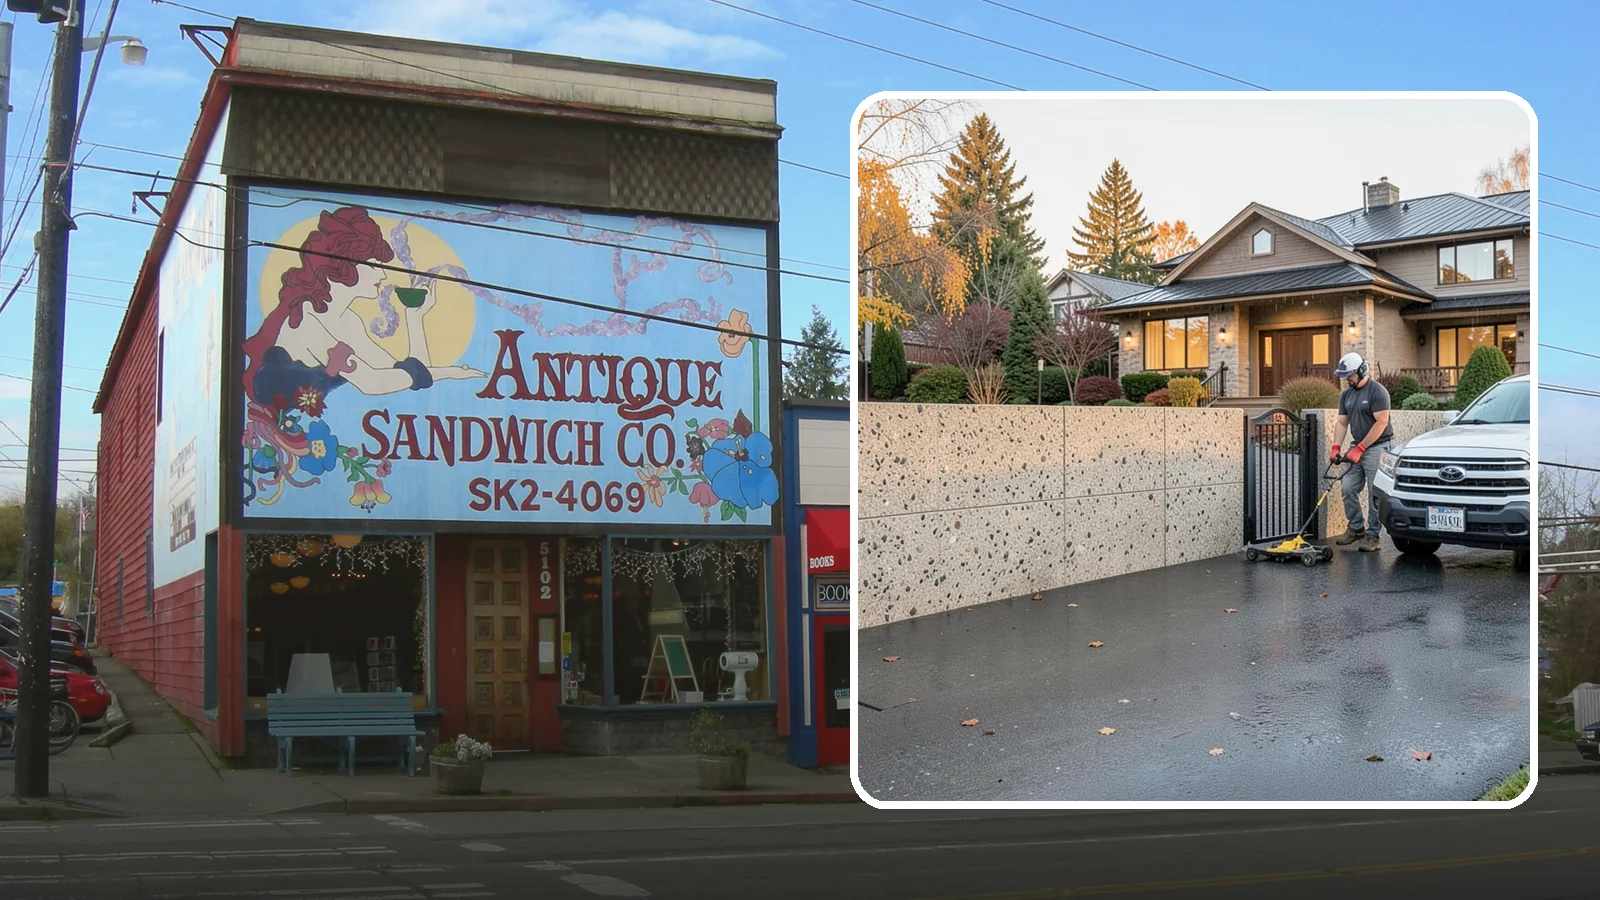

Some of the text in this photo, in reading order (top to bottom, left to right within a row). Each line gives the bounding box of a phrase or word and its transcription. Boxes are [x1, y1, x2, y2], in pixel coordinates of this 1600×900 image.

[476, 328, 724, 421] ANTIQUE
[361, 408, 685, 469] SANDWICH CO.
[468, 477, 645, 513] SK2-4069
[540, 541, 551, 600] 5102
[809, 554, 835, 569] BOOKS
